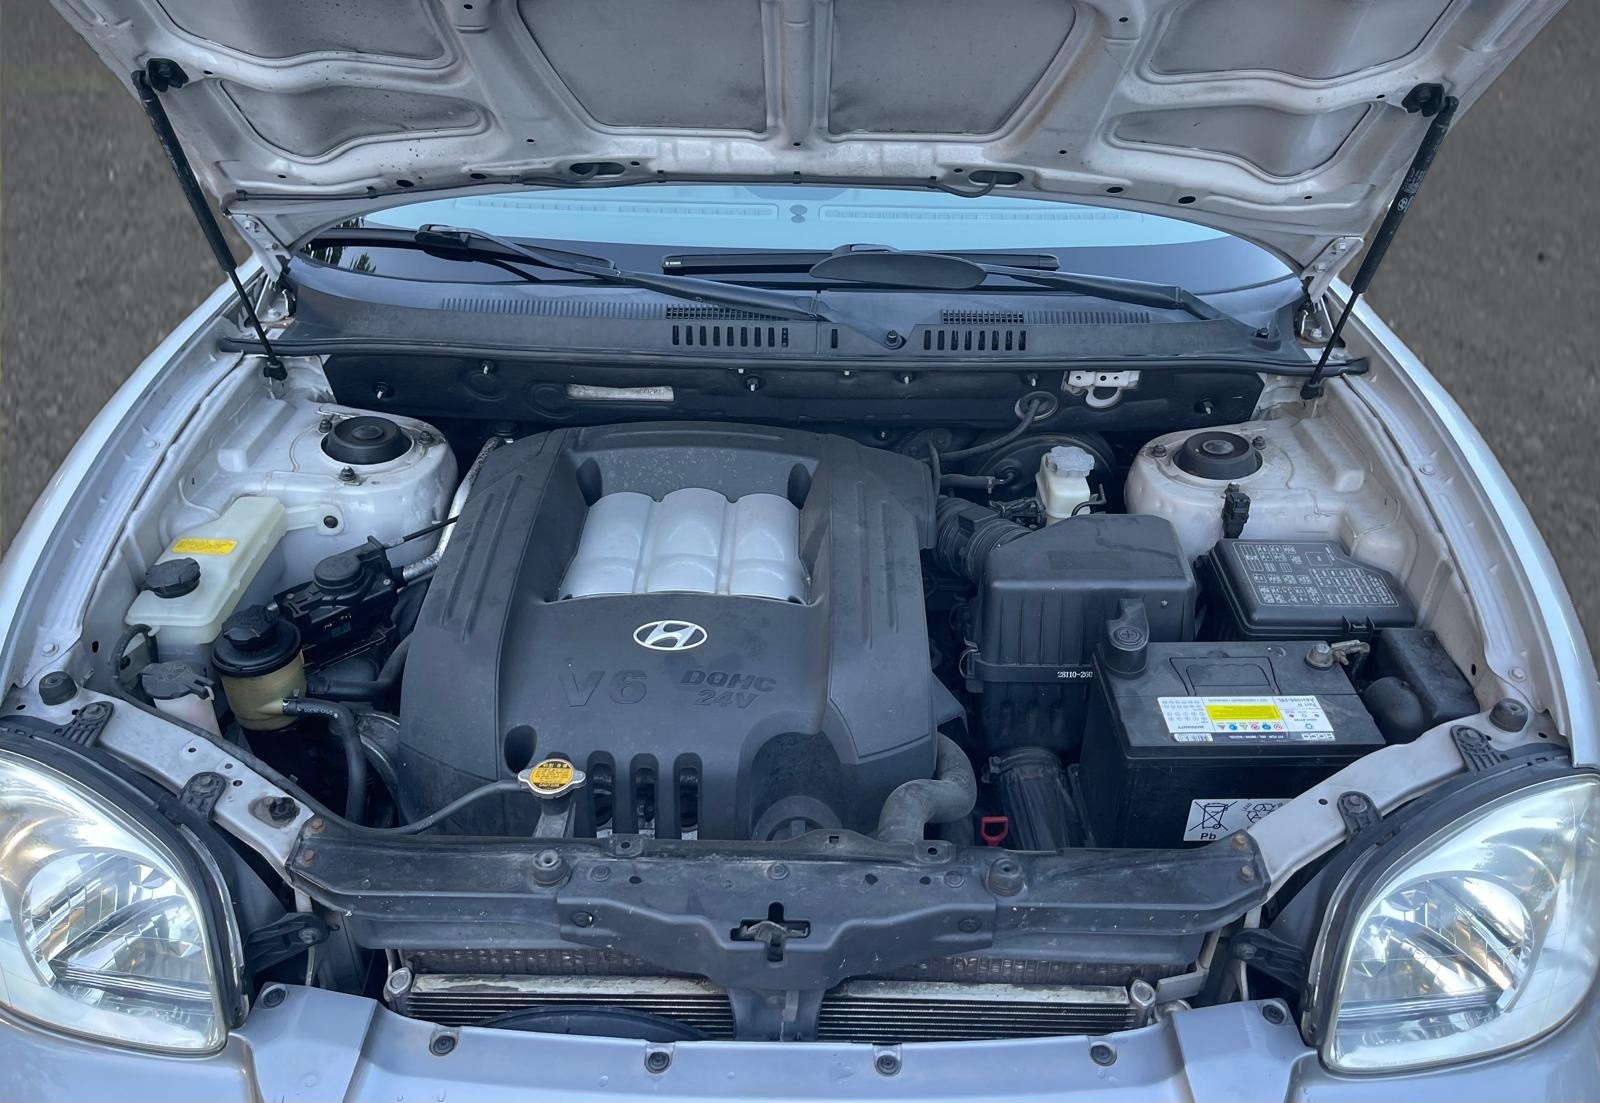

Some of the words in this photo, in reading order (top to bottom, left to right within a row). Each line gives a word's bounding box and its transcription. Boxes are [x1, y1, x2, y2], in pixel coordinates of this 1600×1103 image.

[558, 669, 648, 708] V6
[680, 670, 776, 693] DOHC
[694, 689, 759, 709] 24V
[1200, 832, 1217, 840] Pb
